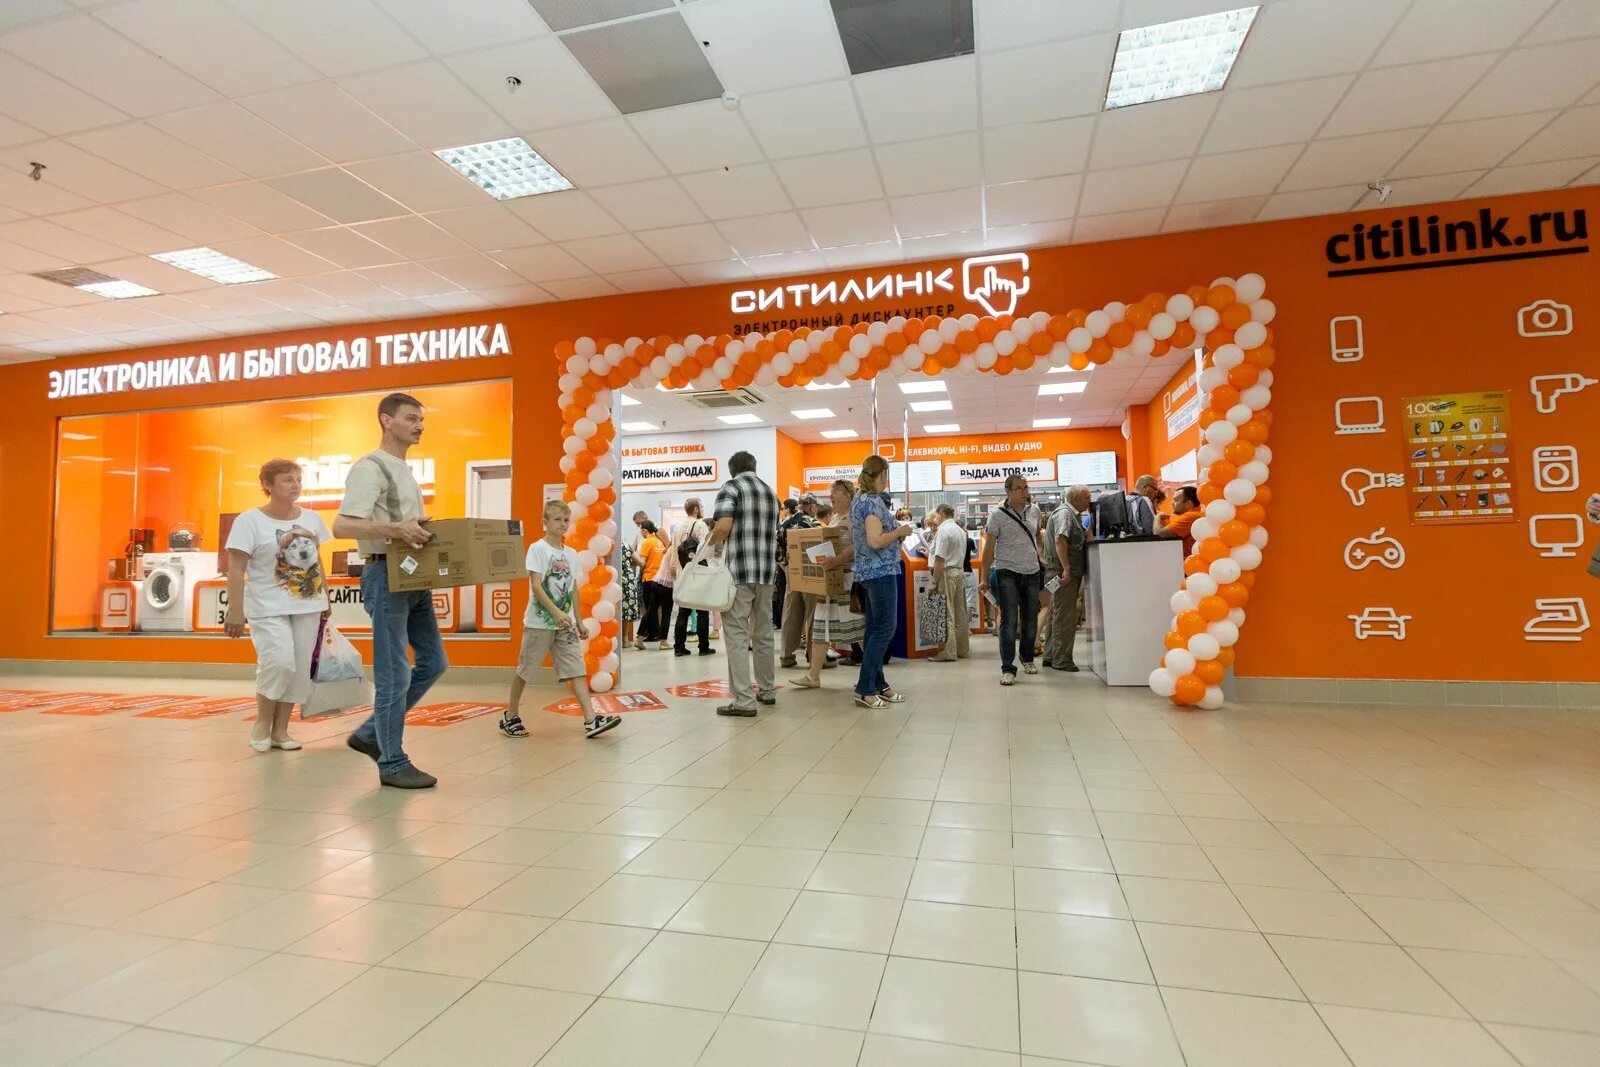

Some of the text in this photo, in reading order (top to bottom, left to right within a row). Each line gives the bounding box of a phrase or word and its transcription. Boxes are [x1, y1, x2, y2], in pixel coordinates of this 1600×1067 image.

[1325, 208, 1588, 264] citilink.ru
[731, 267, 954, 313] СИТИЛИНК
[734, 304, 955, 335] ЭЛЕКТРОННЫЙ ДИСКАУНТЕР
[47, 323, 510, 399] ЭЛЕКТРОНИКА И БЫТОВАЯ ТЕХНИКА
[631, 446, 668, 456] БЫТОВАЯ
[670, 444, 705, 454] ТЕХНИКА
[983, 444, 1011, 453] ВИДЕО
[1014, 442, 1043, 451] АУДИО
[672, 466, 712, 477] ПРОДАЖ
[960, 468, 1000, 480] ВЫДАЧА
